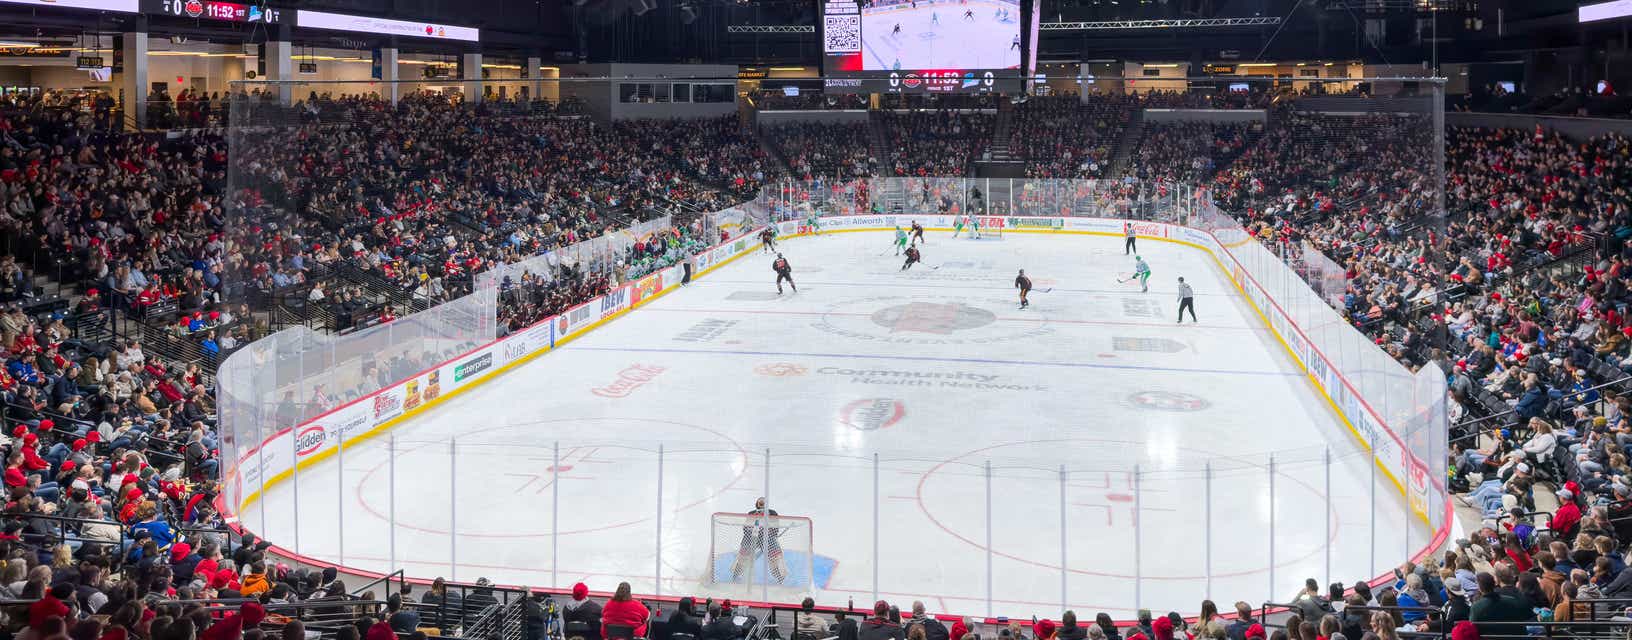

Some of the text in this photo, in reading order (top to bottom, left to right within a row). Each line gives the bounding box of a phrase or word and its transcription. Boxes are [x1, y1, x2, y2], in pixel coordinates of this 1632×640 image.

[173, 0, 182, 15] 0
[207, 4, 245, 18] 11:52 1ST
[265, 9, 272, 23] 0
[889, 72, 899, 87] 0
[923, 72, 959, 84] 11:52
[984, 71, 994, 86] 0
[852, 217, 883, 226] Allworth
[600, 287, 625, 313] IBEW
[455, 356, 492, 377] enterprise
[1310, 350, 1327, 381] IBEW
[816, 366, 1000, 382] Community
[851, 375, 1048, 392] Health Network
